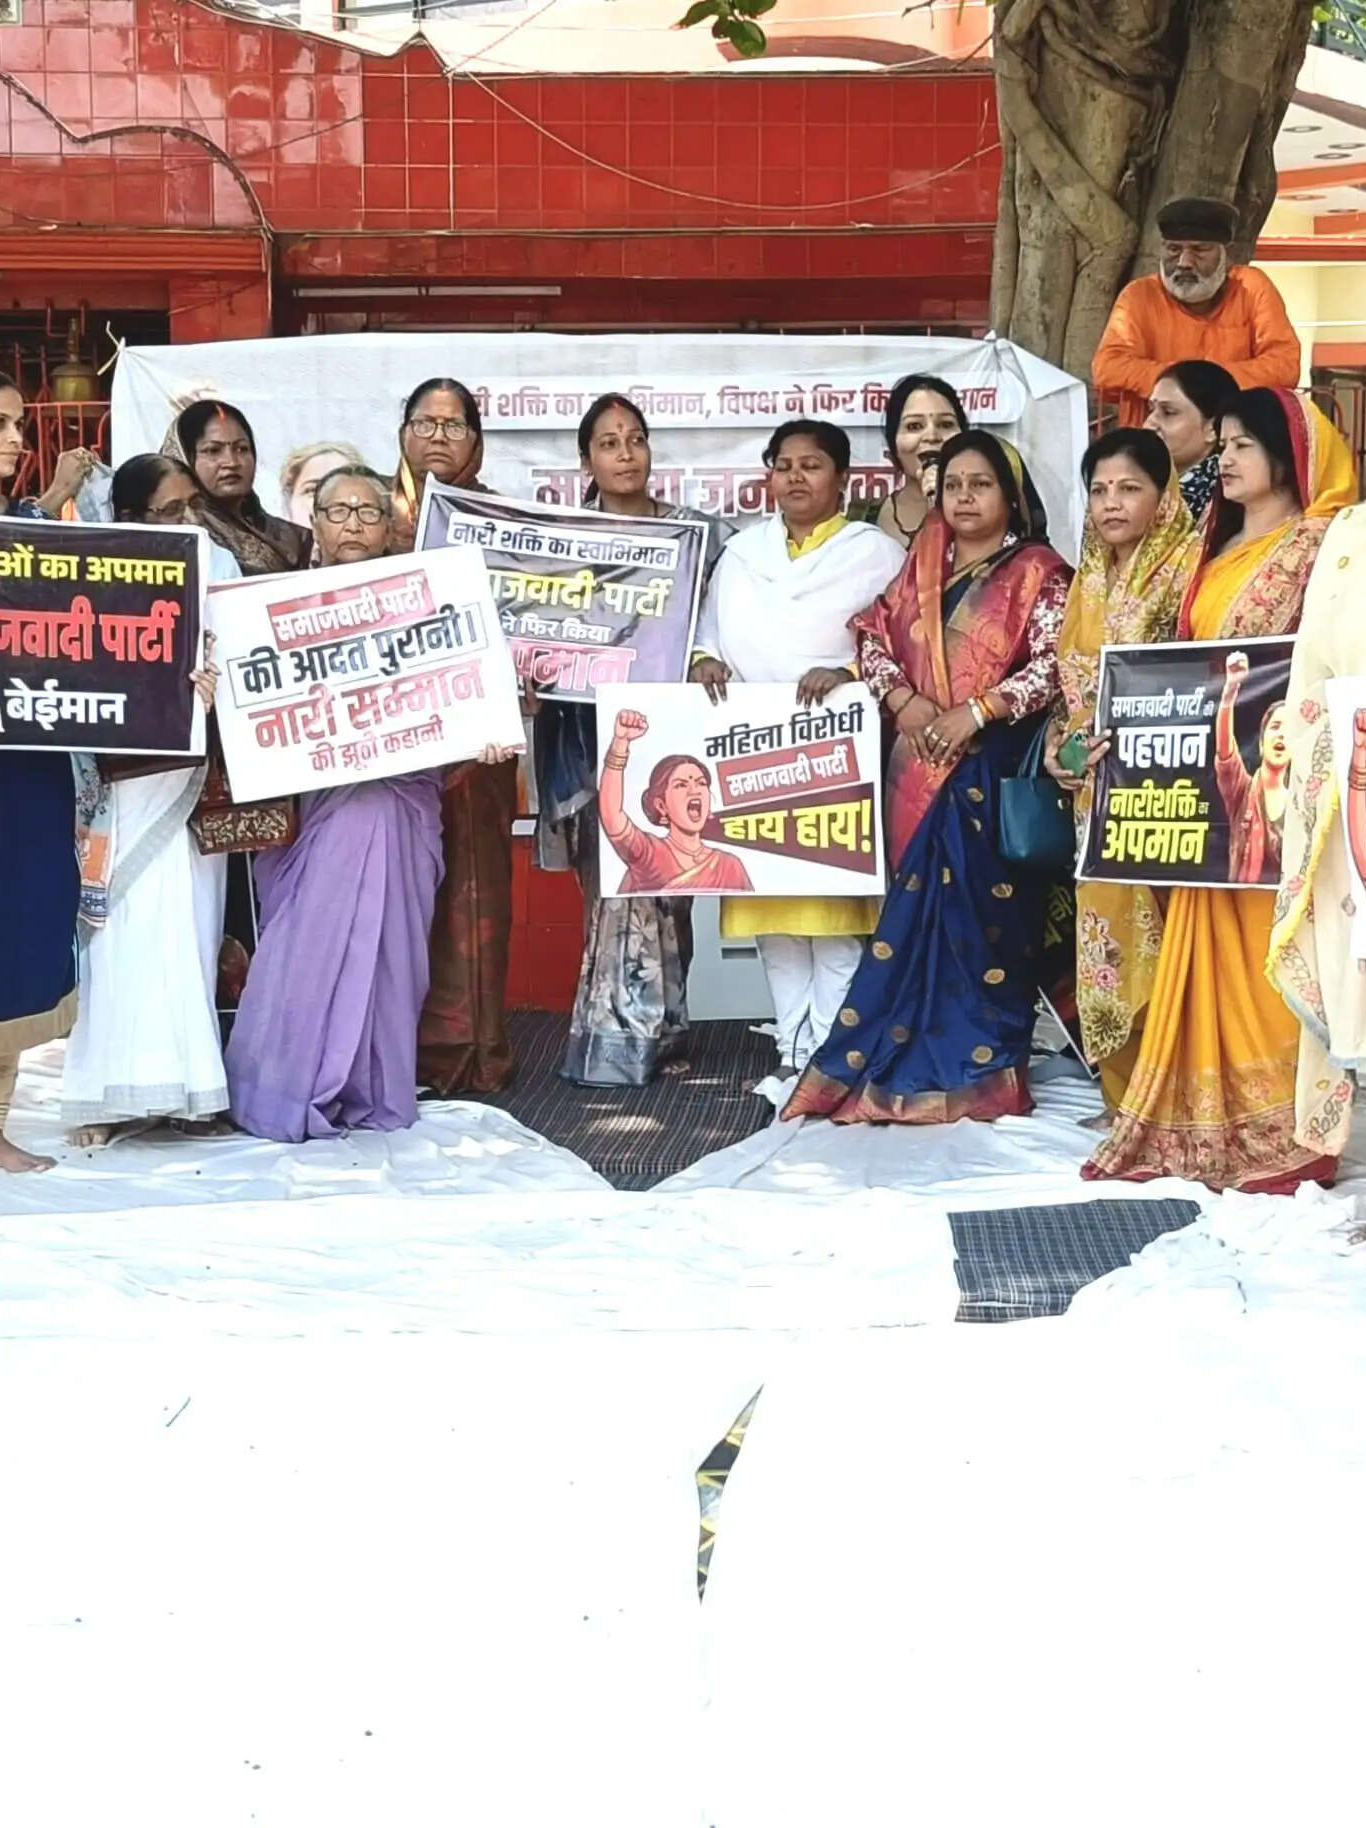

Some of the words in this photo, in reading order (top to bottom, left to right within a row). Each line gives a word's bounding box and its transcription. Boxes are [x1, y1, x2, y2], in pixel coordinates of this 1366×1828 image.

[782, 383, 806, 414] ने
[811, 382, 857, 414] फिर
[38, 553, 80, 581] का
[85, 556, 187, 587] अपमान
[452, 521, 498, 548] नारी
[500, 526, 545, 554] शक्ति
[548, 535, 574, 557] का
[576, 537, 675, 568] स्वाभिमान
[271, 586, 382, 642] समाजवादी
[377, 574, 426, 617] पार्टी
[488, 568, 597, 611] ाजवादी
[602, 576, 675, 618] पार्टी
[99, 599, 181, 664] पार्टी
[519, 613, 564, 640] फिर
[562, 617, 613, 644] किया
[237, 645, 283, 695] की
[289, 635, 369, 684] आदत
[506, 635, 637, 692] पमान
[3, 677, 128, 732] बेईमान
[248, 682, 337, 748] नारी
[341, 658, 486, 731] सम्मान
[1110, 687, 1176, 719] समाजवादी
[1176, 685, 1207, 718] पार्टी
[308, 742, 335, 772] की
[381, 713, 445, 754] कहानी
[704, 722, 785, 759] महिला
[788, 701, 866, 745] विरोधी
[1117, 724, 1211, 769] पहचान
[726, 752, 812, 798] समाजवादी
[811, 743, 850, 780] पार्टी
[719, 809, 789, 845] हाय
[792, 798, 873, 855] हाय!
[1101, 820, 1210, 865] अपमान
